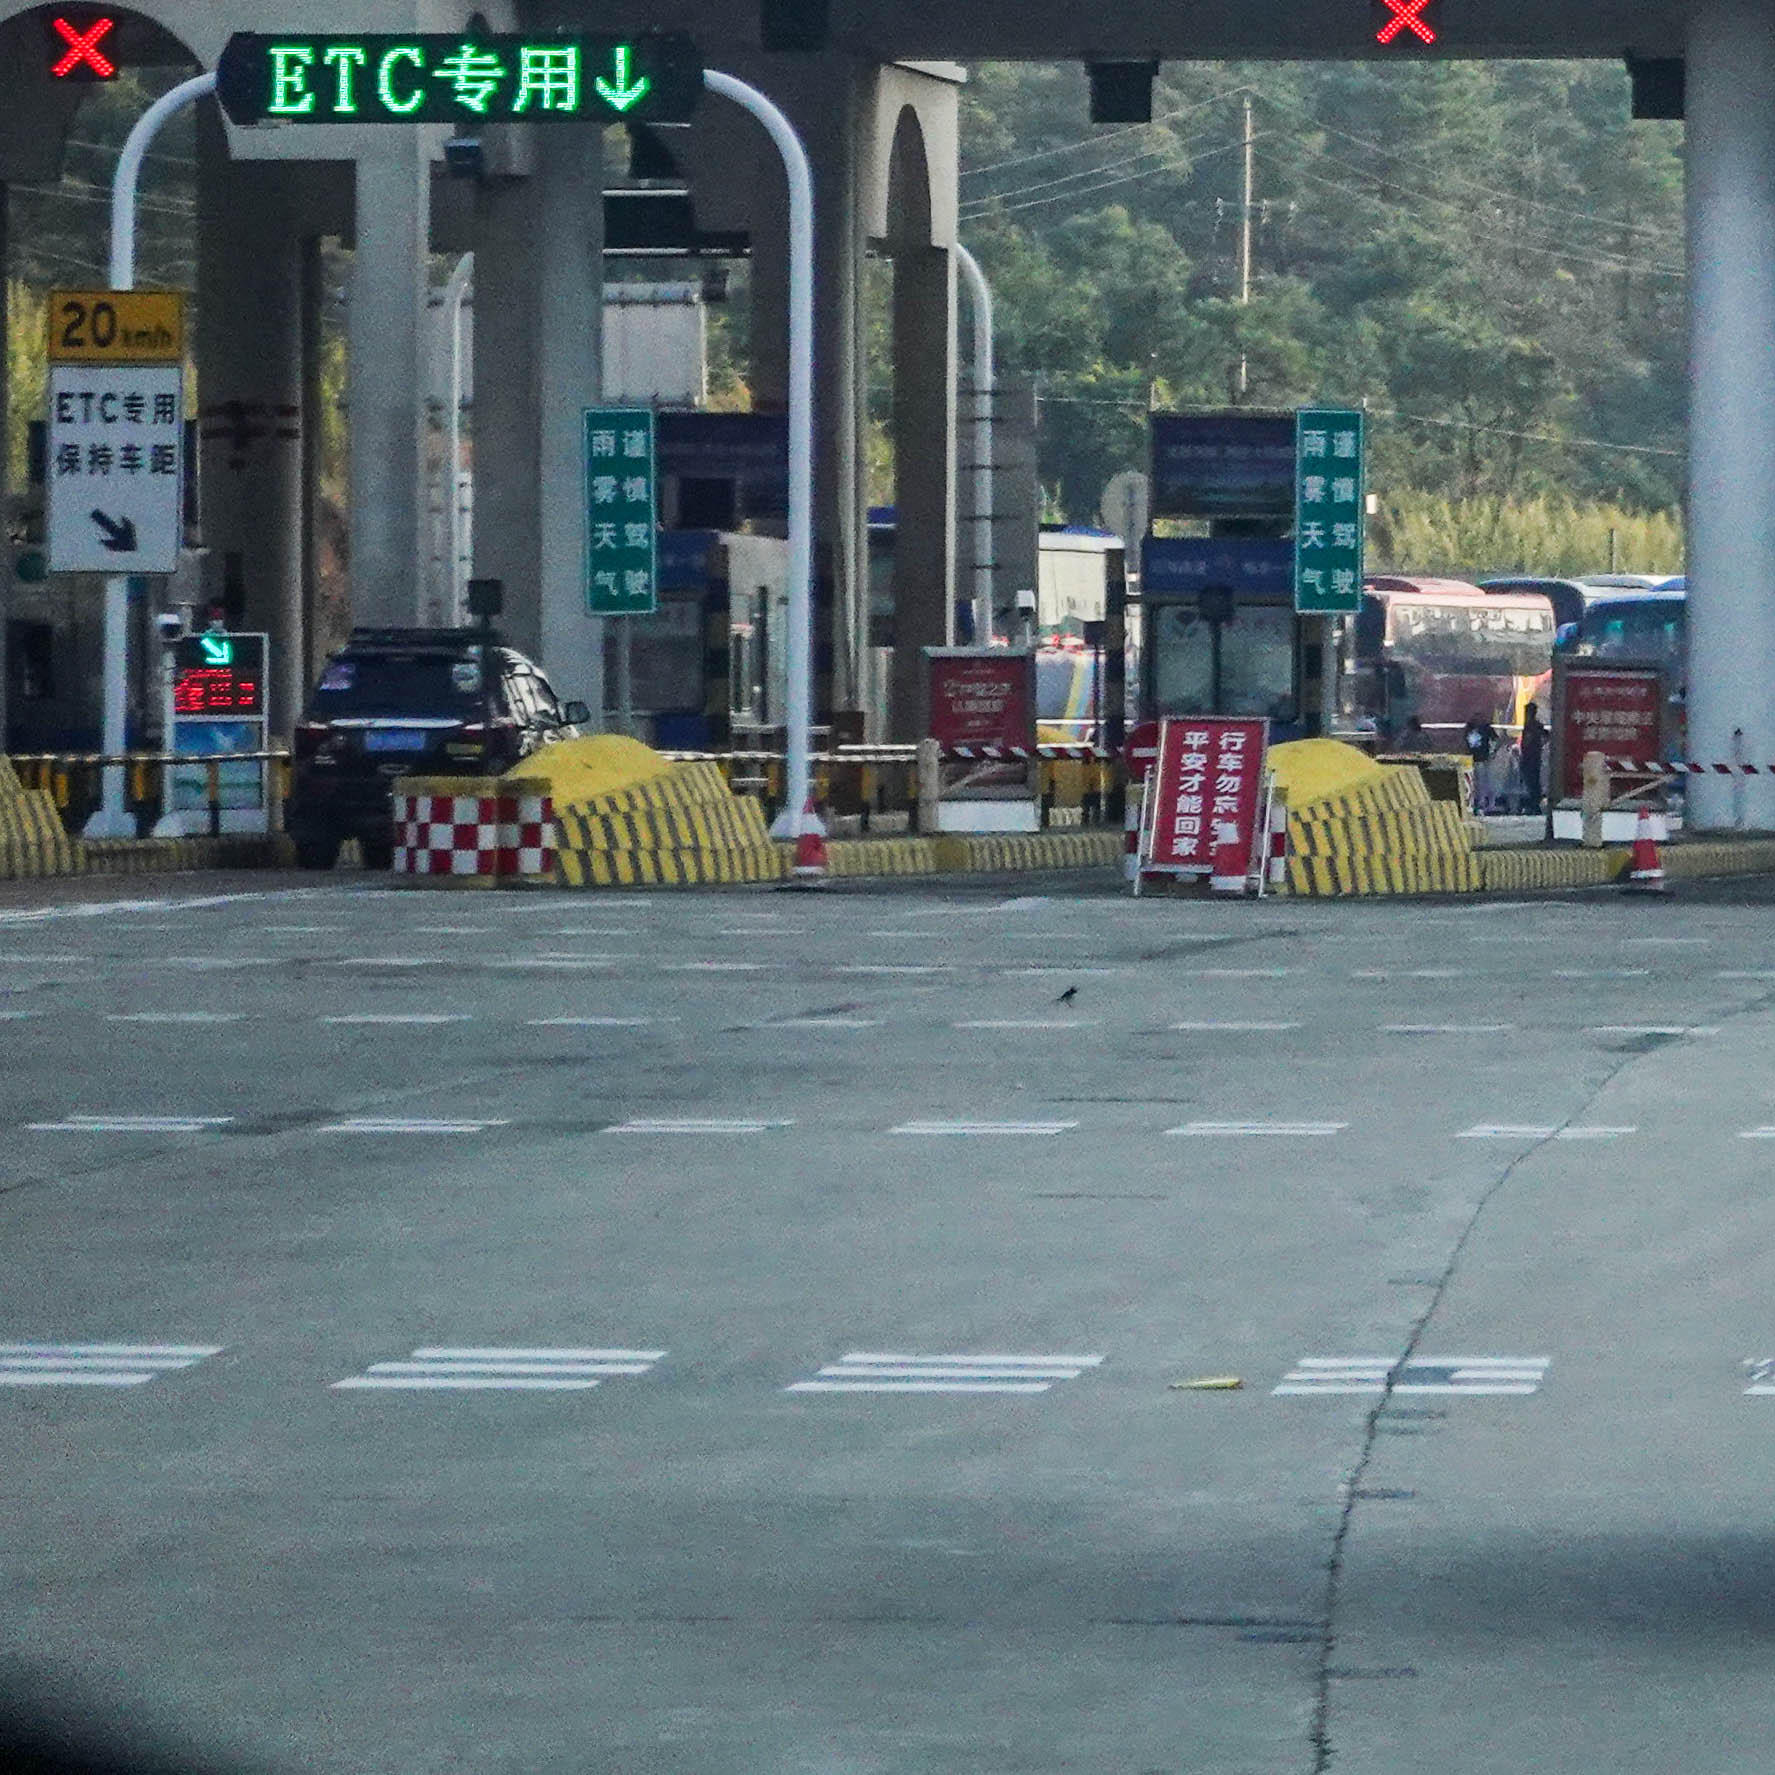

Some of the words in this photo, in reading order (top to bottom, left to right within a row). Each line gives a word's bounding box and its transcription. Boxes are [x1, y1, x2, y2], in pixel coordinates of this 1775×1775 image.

[268, 35, 579, 113] ETC专用
[61, 301, 117, 348] 20
[56, 392, 176, 425] ETC专用
[56, 443, 177, 475] 保持车距
[1171, 731, 1211, 857] 平安才能回家
